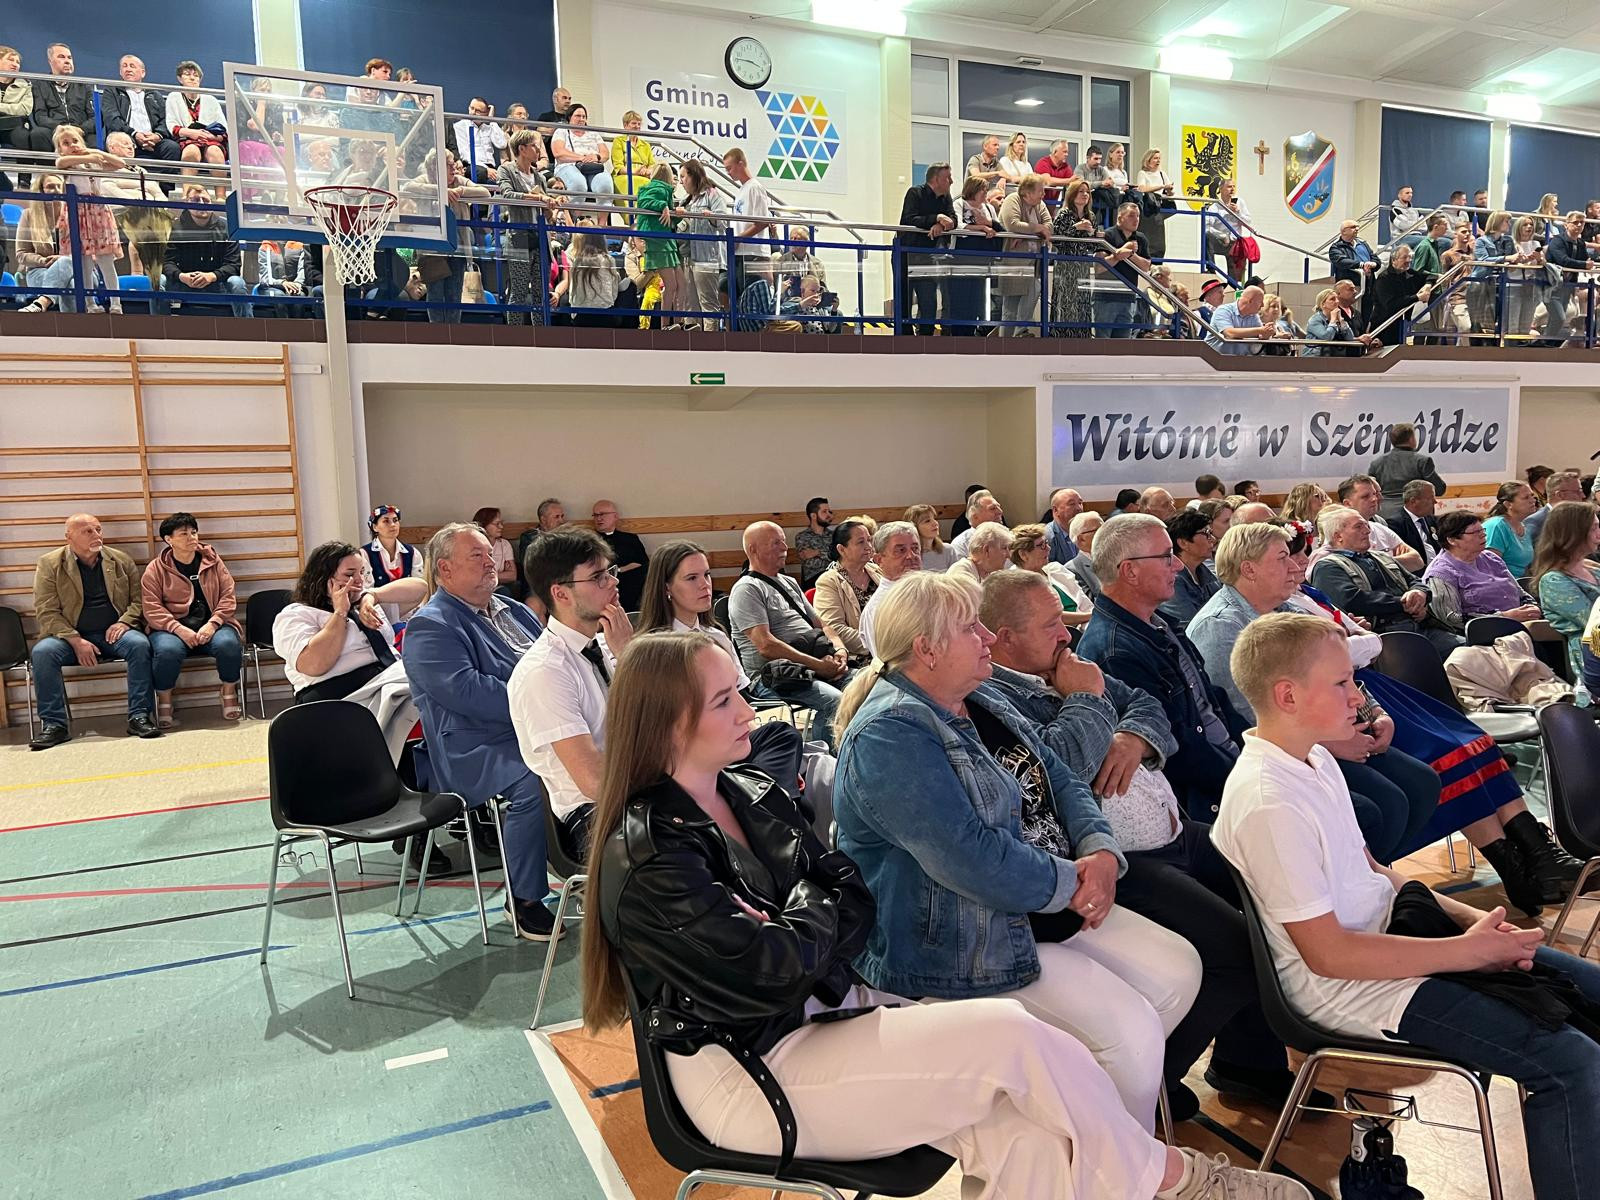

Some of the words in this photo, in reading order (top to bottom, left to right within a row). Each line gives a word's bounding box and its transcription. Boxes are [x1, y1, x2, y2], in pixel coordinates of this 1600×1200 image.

[646, 80, 729, 109] Gmina
[647, 109, 748, 139] Szemud
[1066, 410, 1241, 462] Witómë
[1256, 424, 1290, 458] w
